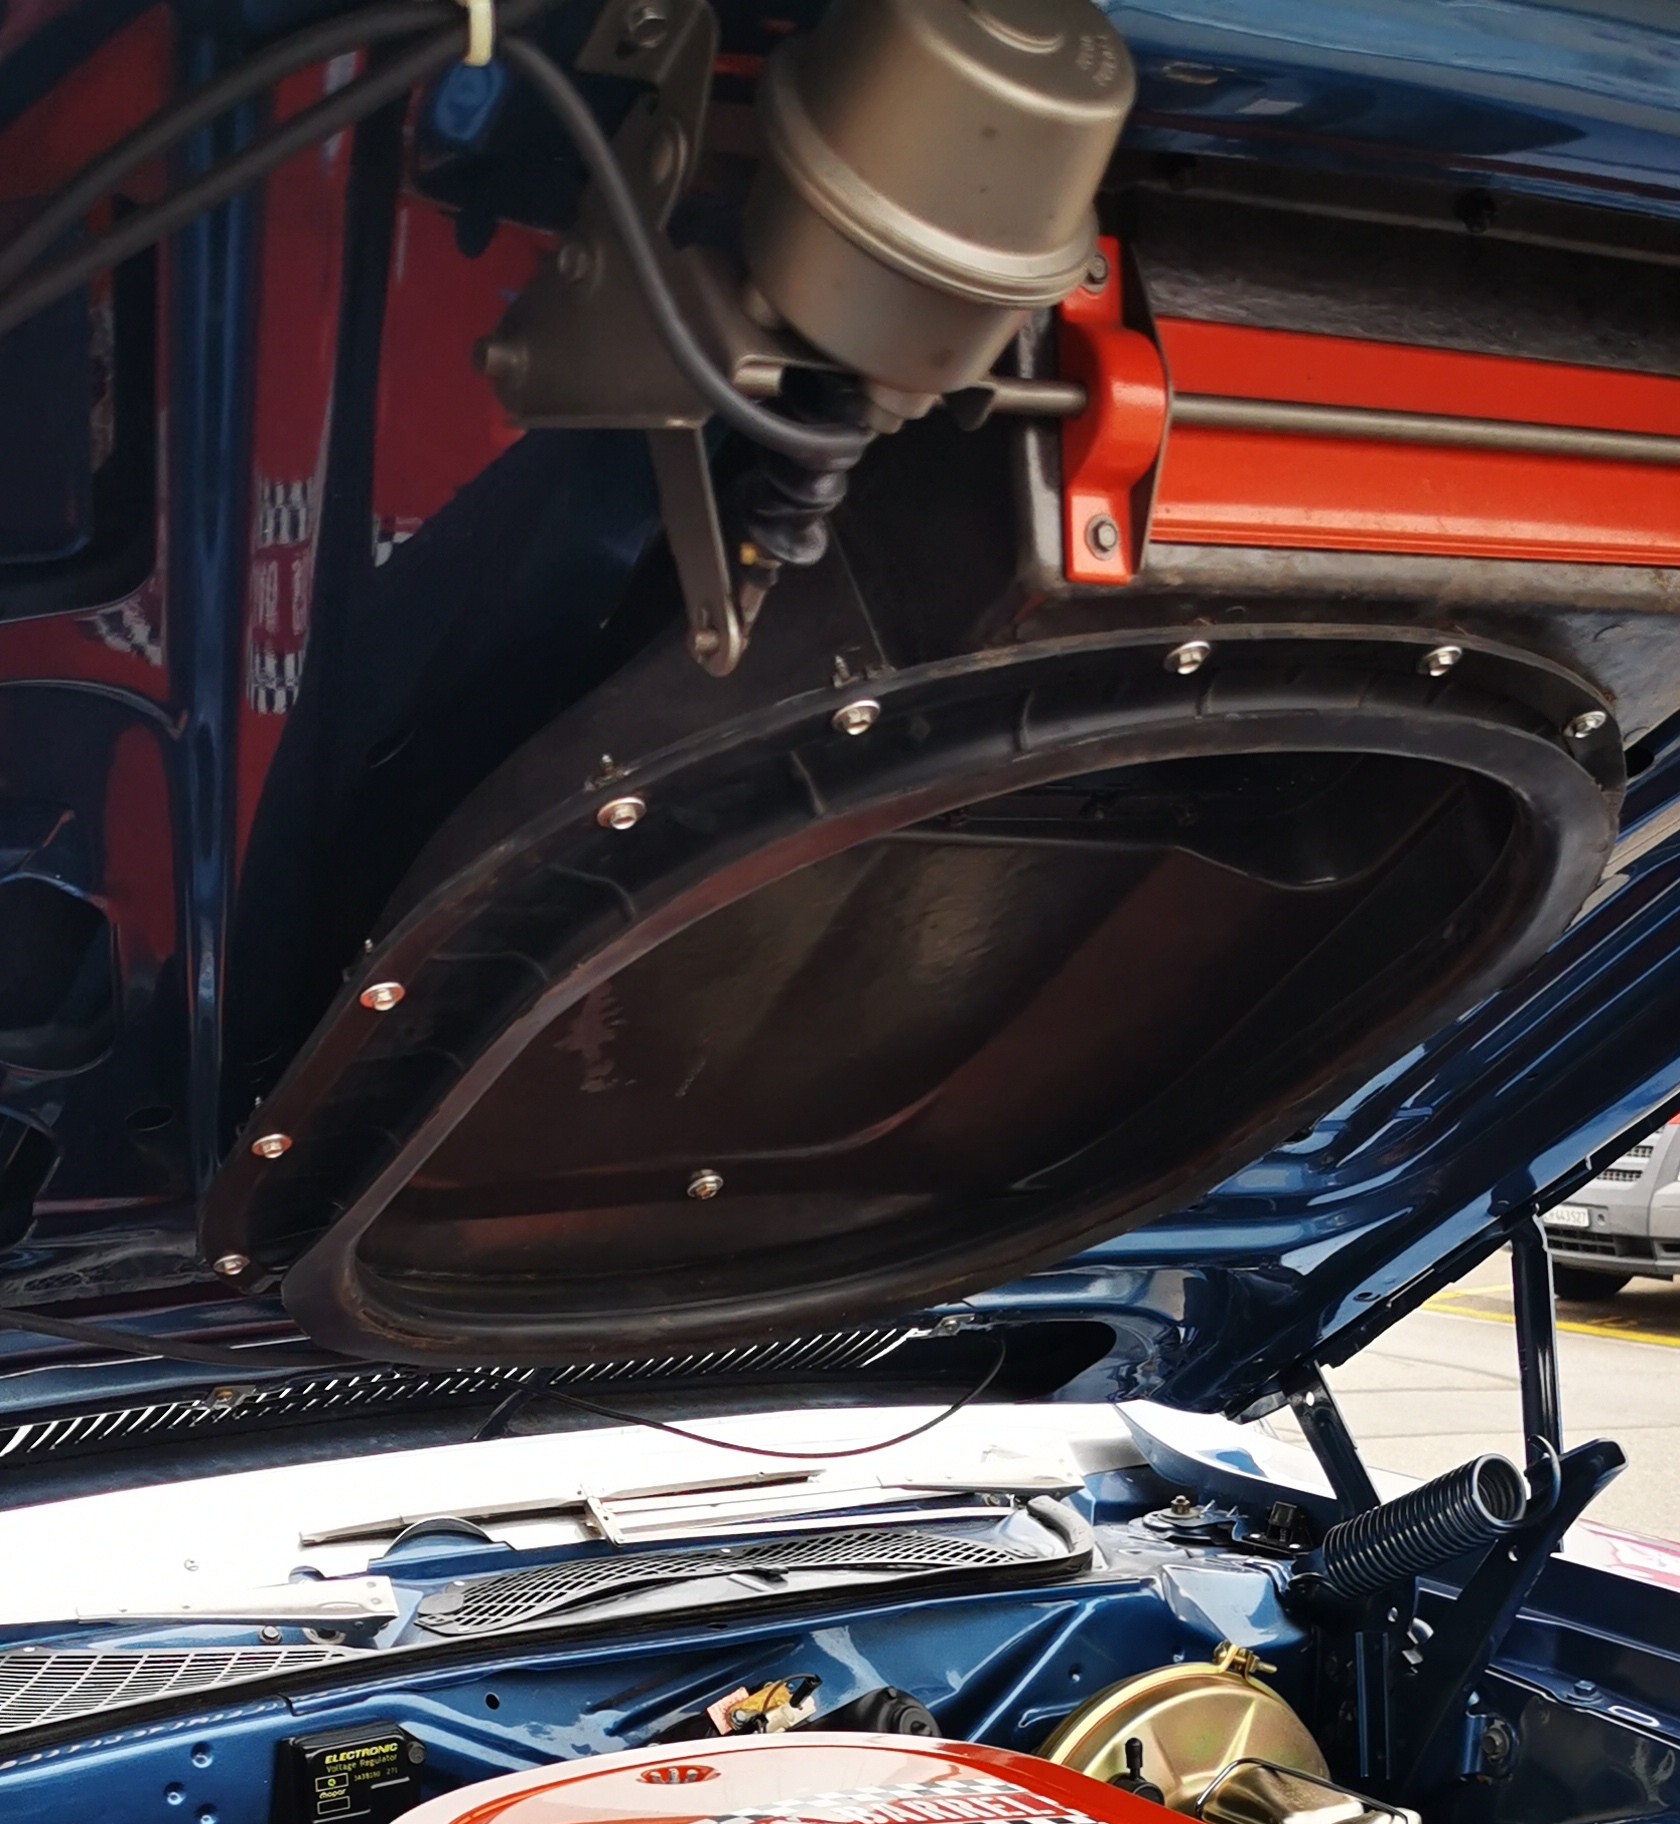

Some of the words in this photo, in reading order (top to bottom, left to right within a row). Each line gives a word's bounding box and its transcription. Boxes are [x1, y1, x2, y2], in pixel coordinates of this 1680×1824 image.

[325, 1743, 398, 1764] ELECTRONIC
[326, 1761, 357, 1774] Voltage
[359, 1754, 398, 1768] Regulator
